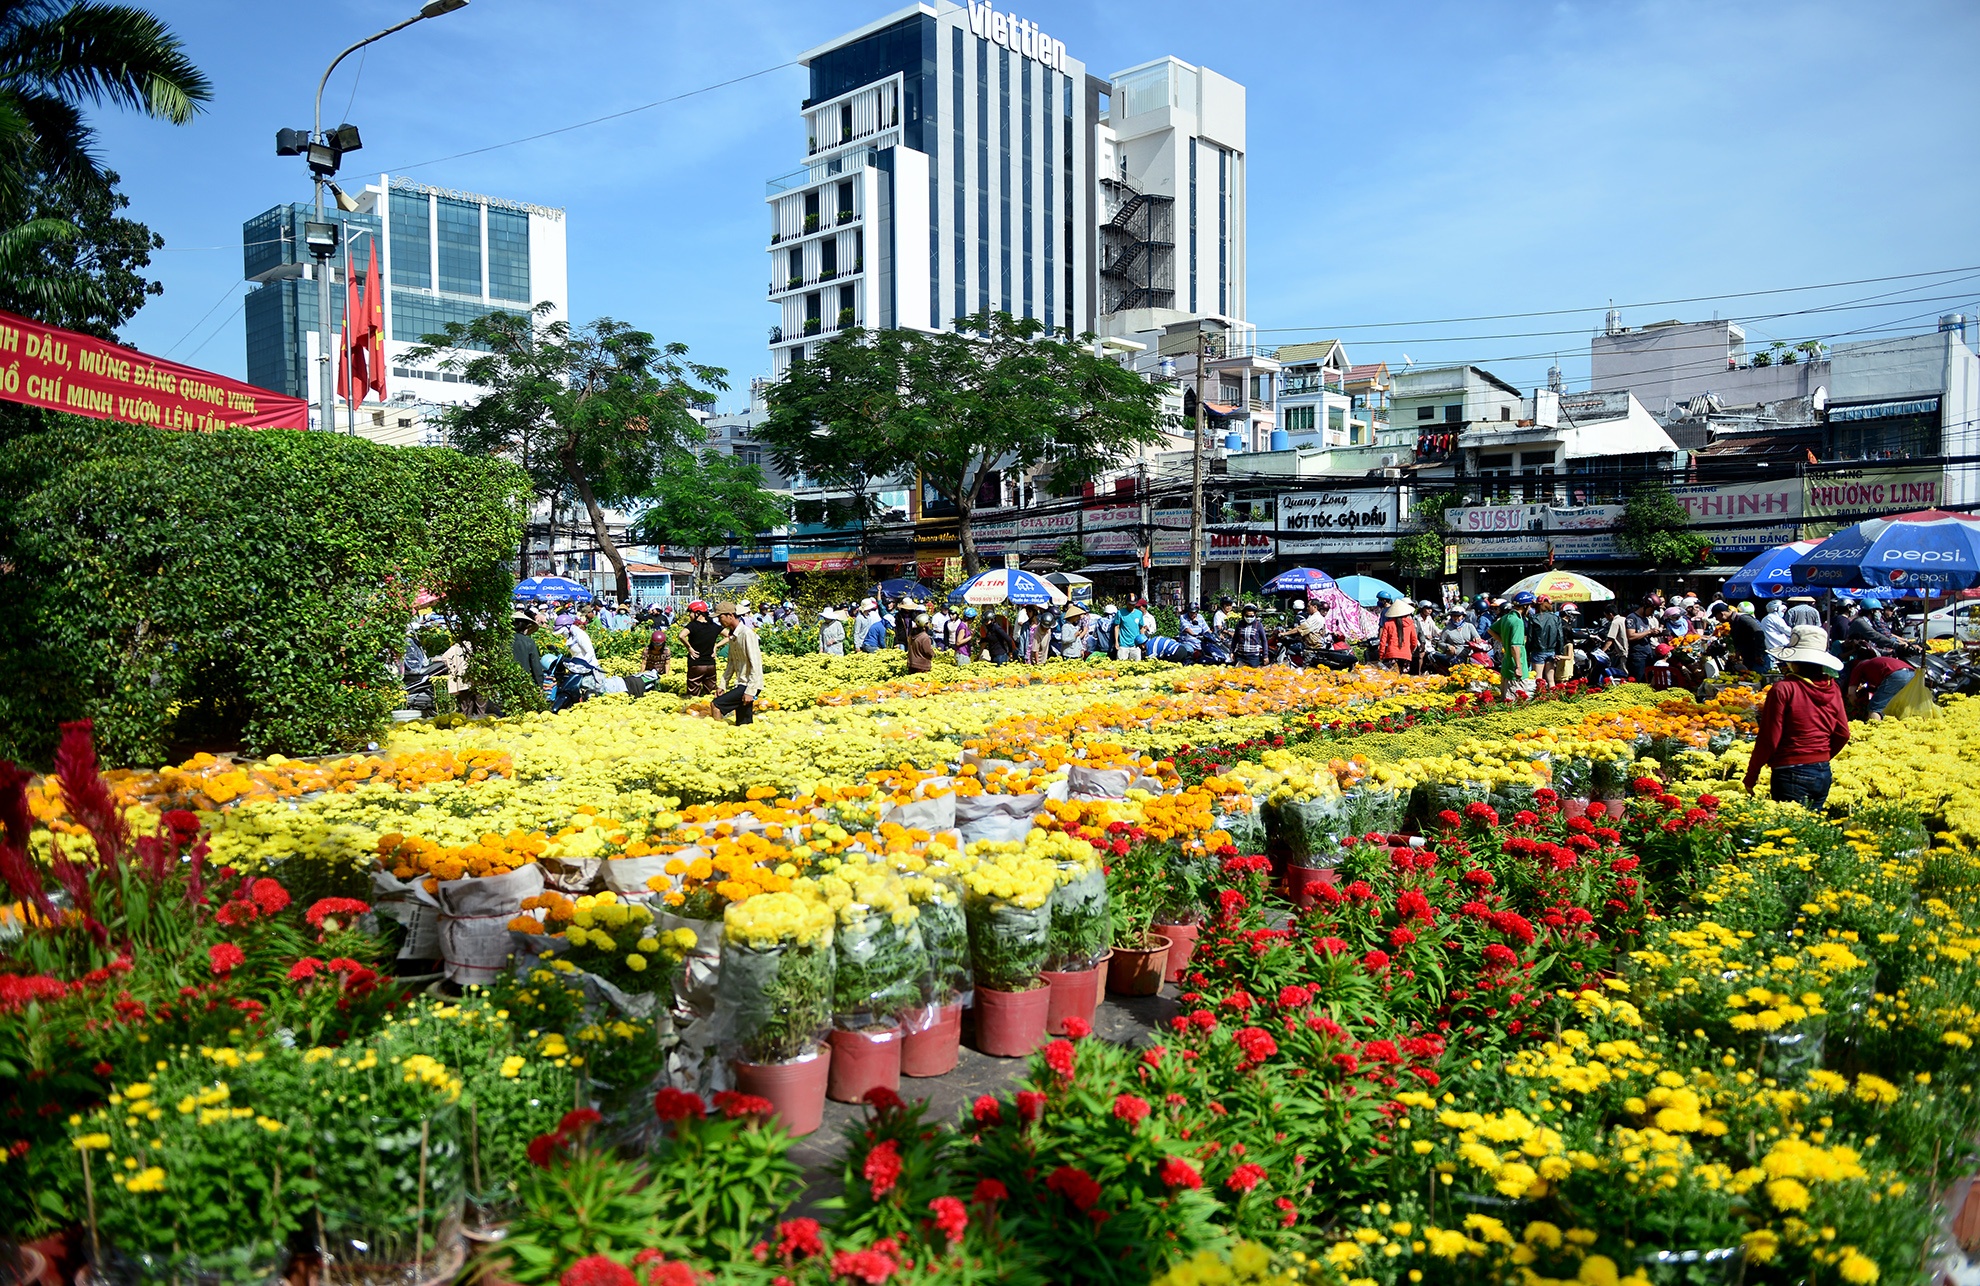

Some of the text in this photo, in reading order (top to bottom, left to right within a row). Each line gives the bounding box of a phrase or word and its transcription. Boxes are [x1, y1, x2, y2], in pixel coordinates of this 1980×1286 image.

[966, 0, 1066, 73] Viettien
[520, 202, 563, 222] GROUP
[26, 333, 72, 371] DẬU,
[79, 348, 130, 382] MỪNG
[134, 362, 176, 394] ĐẢNG
[179, 378, 224, 407] QUANG
[27, 375, 63, 403] CHÍ
[66, 383, 113, 414] MINH
[118, 396, 160, 424] VƯƠN
[165, 404, 194, 431] LÊN
[1283, 494, 1348, 508] Quang Long
[1810, 482, 1936, 506] PHƯƠNG LINH
[1678, 493, 1788, 520] THỊNH
[1021, 518, 1044, 527] GIA
[1089, 510, 1141, 522] SUSU
[1288, 512, 1310, 529] HỚT
[1362, 506, 1386, 526] ĐẦU
[1468, 510, 1522, 530] SUSU
[1211, 534, 1270, 548] MIMOSA
[1731, 534, 1756, 544] TÍNH
[1760, 532, 1788, 544] BẢNG
[1809, 545, 1867, 561] pepsi
[1882, 549, 1960, 563] pepsi
[1818, 569, 1844, 580] pepsi
[1910, 573, 1949, 583] pepsi
[1784, 585, 1811, 594] pepsi
